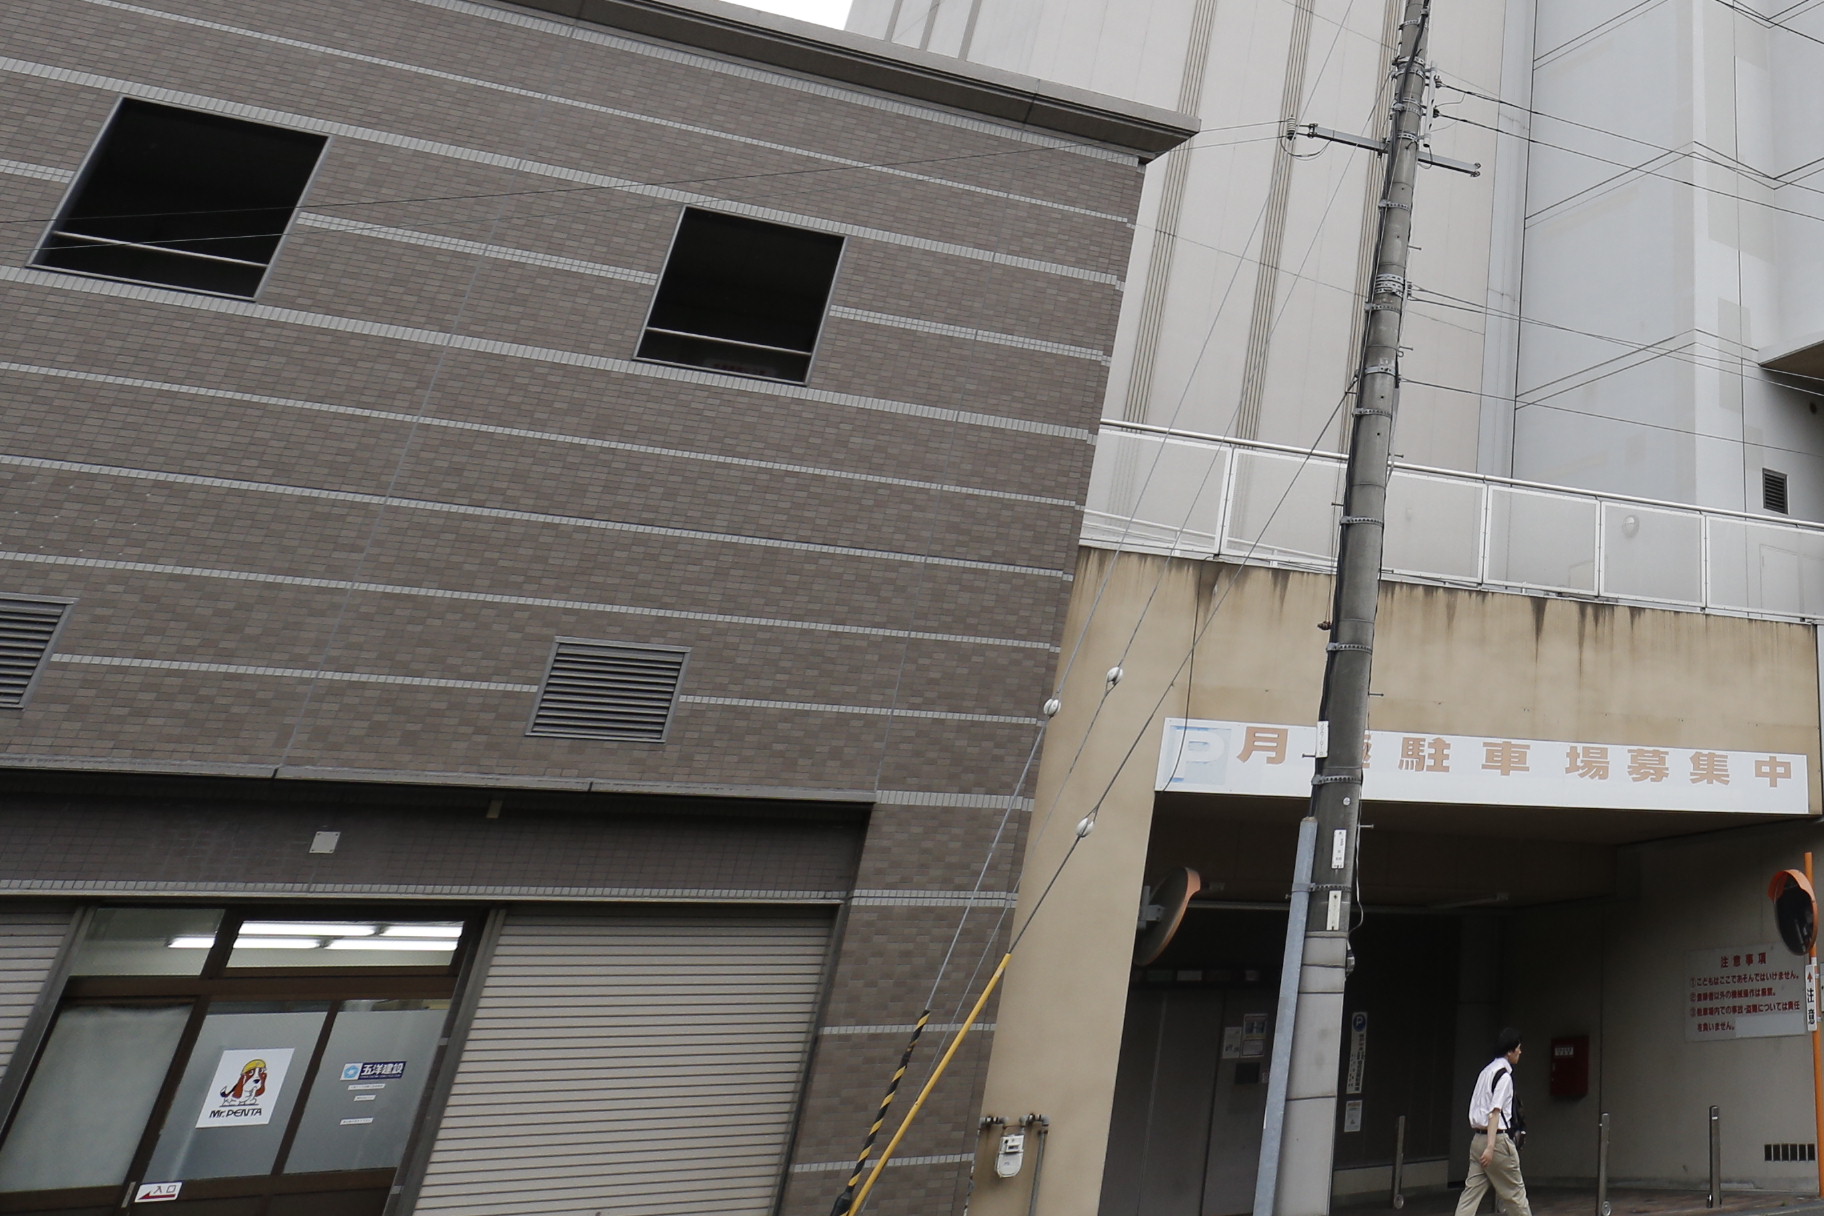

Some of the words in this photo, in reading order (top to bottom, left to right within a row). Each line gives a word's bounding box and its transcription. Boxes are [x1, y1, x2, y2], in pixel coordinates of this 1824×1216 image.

[1237, 726, 1792, 788] 月駐車場募集中
[1720, 952, 1767, 968] 注意事項
[1807, 988, 1815, 1025] 注意
[361, 1063, 404, 1076] 五洋建設
[153, 1184, 177, 1194] 入口
